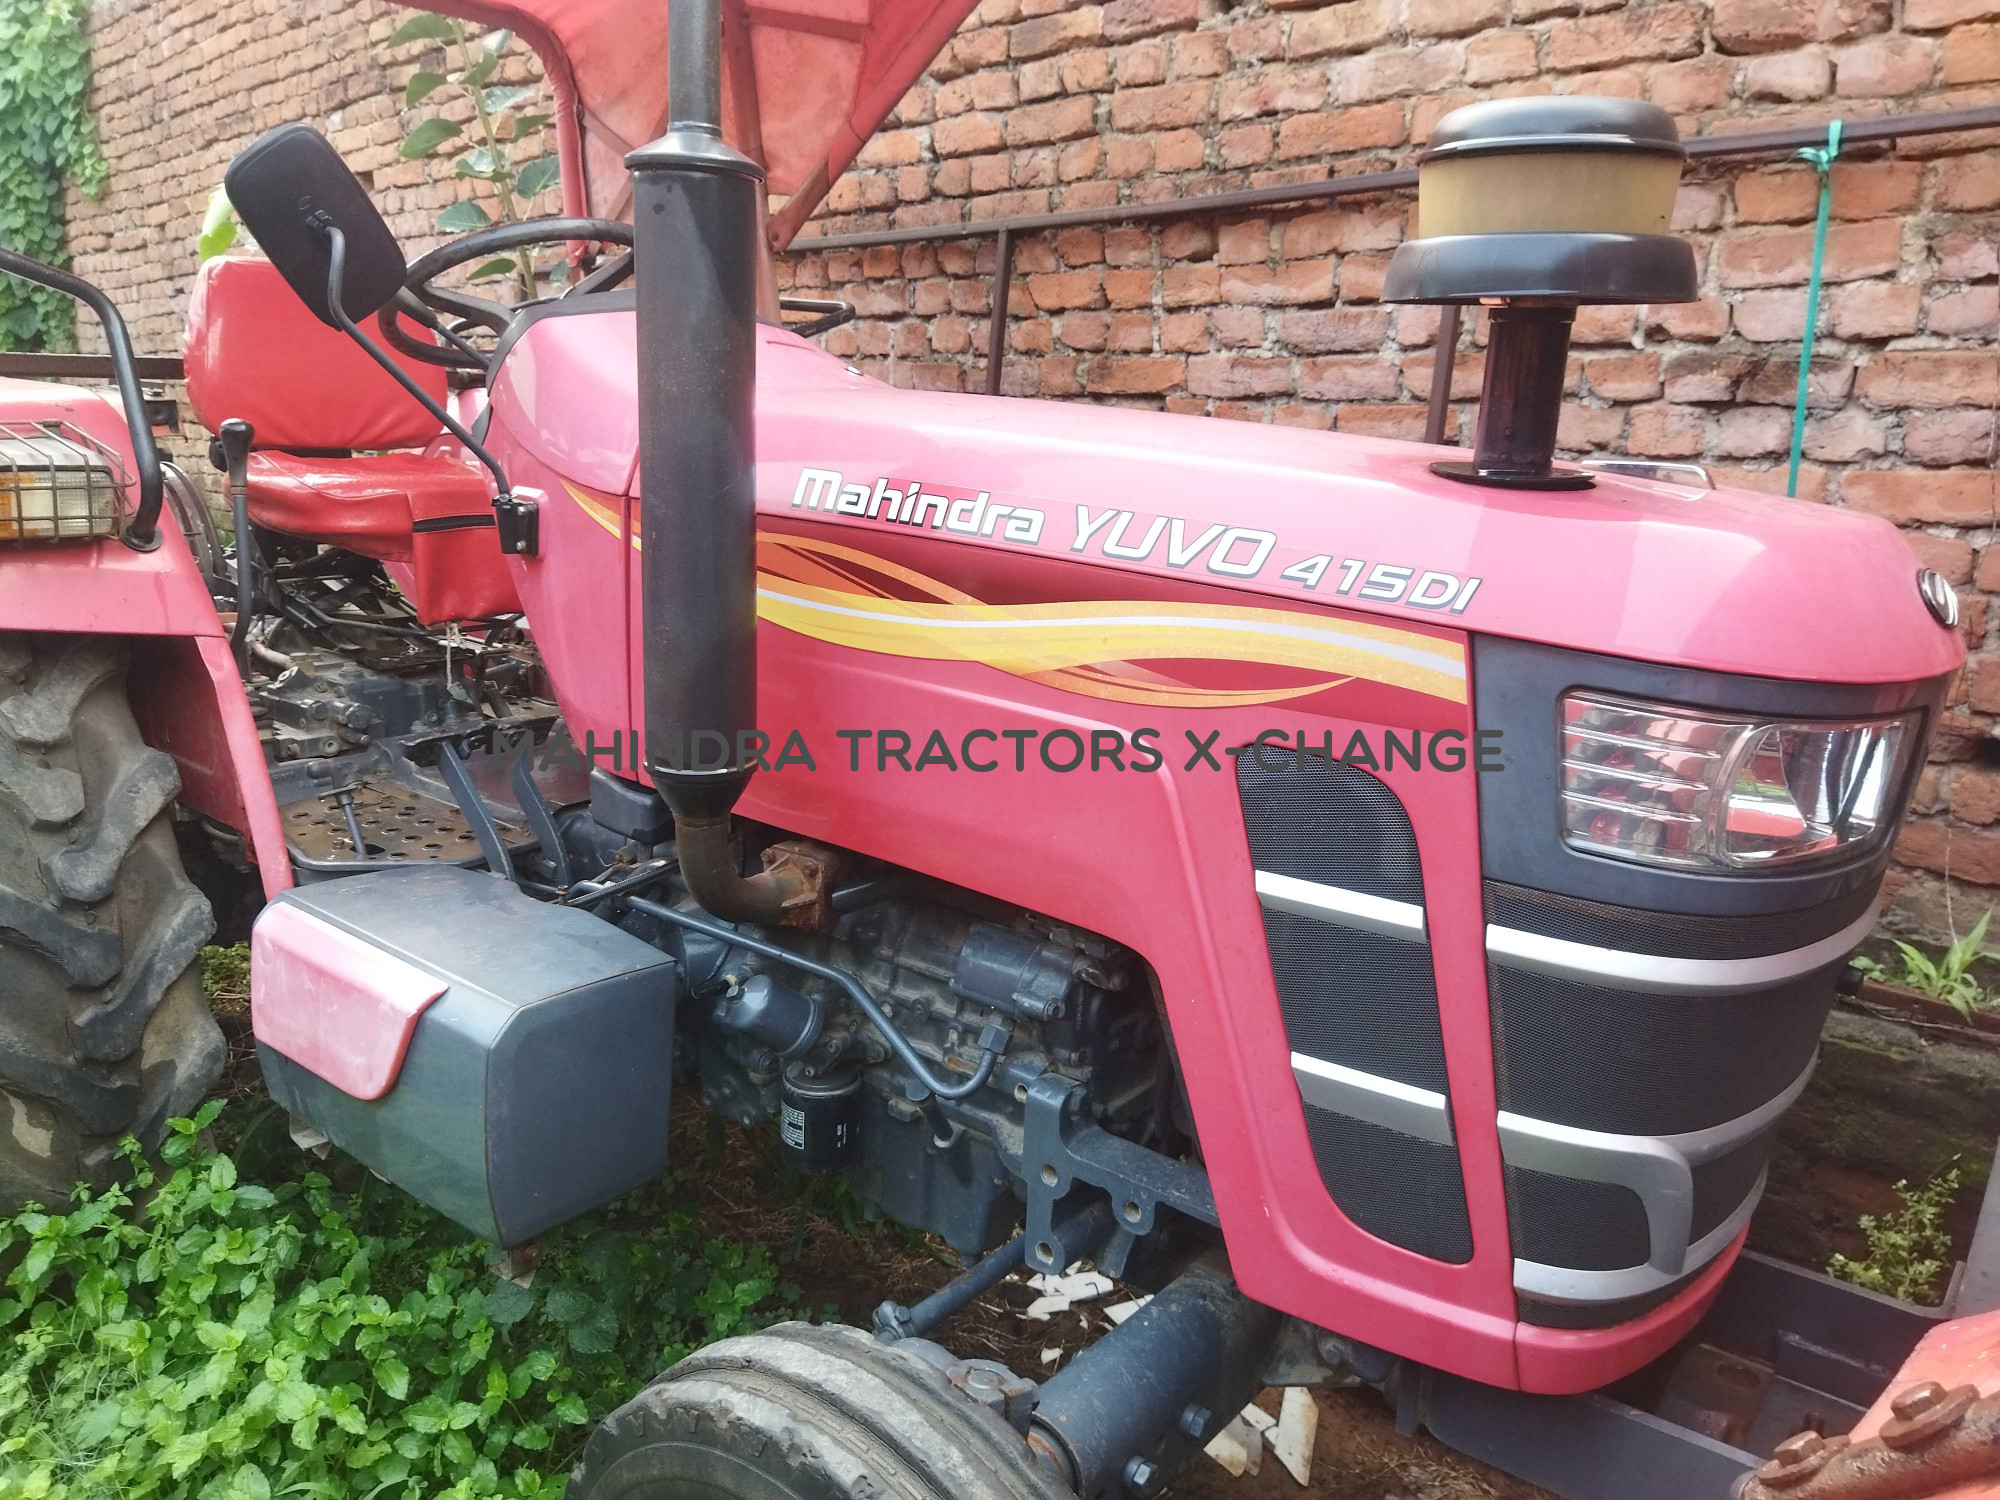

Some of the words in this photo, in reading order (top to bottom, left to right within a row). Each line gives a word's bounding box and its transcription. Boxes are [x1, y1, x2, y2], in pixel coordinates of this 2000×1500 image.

[791, 467, 1045, 545] Mahindra
[1070, 505, 1277, 578] YUVO
[1280, 554, 1482, 614] 415DI
